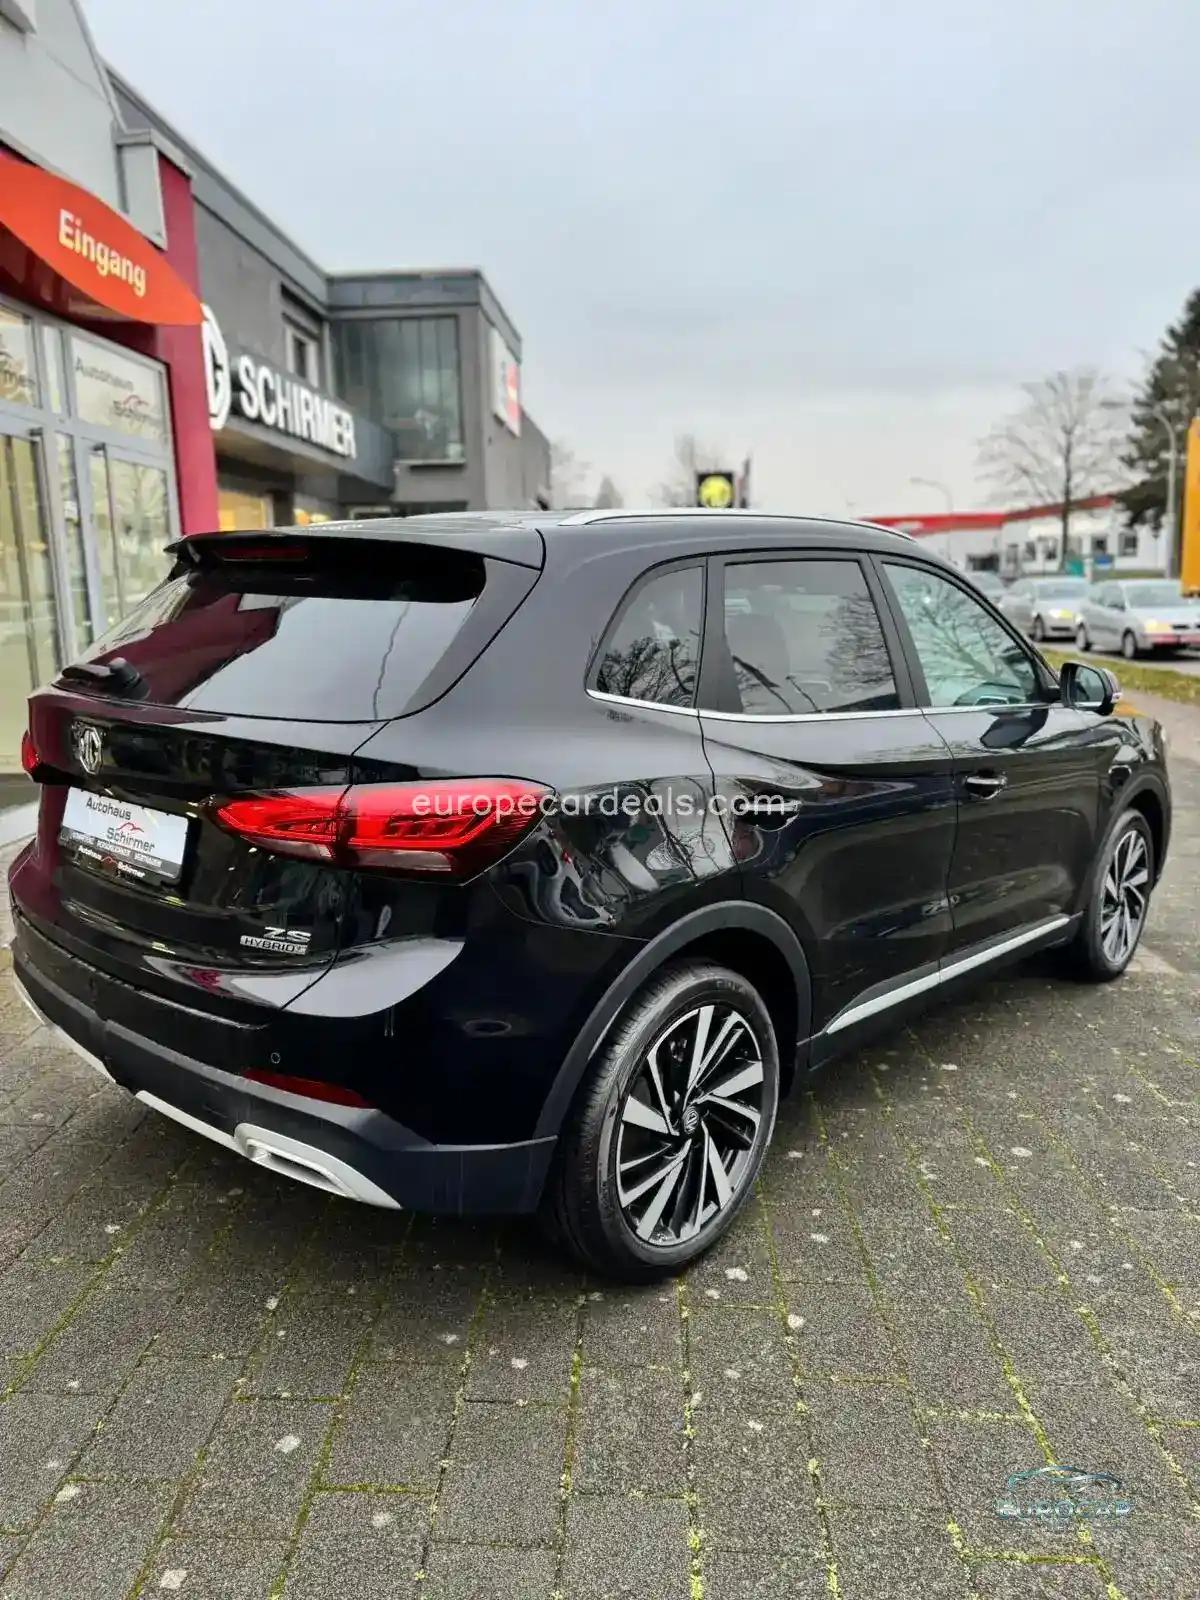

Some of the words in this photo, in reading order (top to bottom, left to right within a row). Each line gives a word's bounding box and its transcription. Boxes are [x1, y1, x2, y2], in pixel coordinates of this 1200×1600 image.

[59, 208, 146, 298] Eingang
[239, 355, 357, 459] SCHIRMER
[86, 797, 132, 821] Autohaus
[106, 827, 155, 853] Schirmer
[264, 926, 312, 943] ZS
